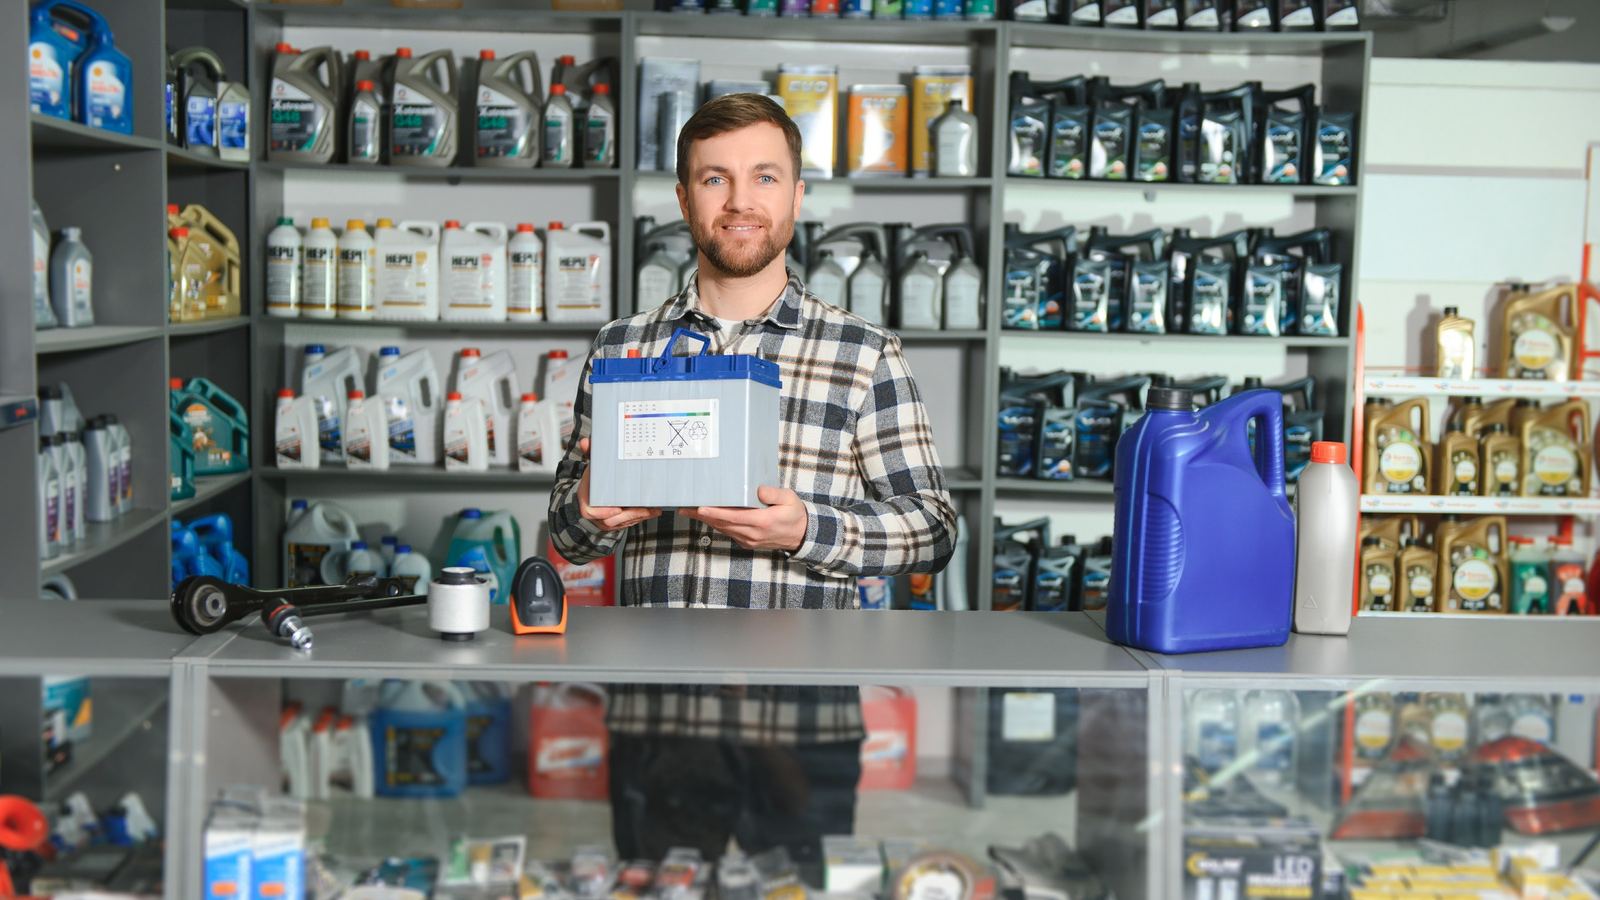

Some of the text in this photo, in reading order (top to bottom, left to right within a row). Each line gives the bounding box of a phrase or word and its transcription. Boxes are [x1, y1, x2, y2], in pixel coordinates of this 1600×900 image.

[268, 246, 293, 258] HEPU
[386, 254, 412, 264] HEPU
[451, 256, 478, 266] HEPU
[512, 252, 538, 263] HEPU
[560, 257, 586, 267] HEPU
[672, 448, 682, 456] Pb
[1274, 856, 1314, 875] LED
